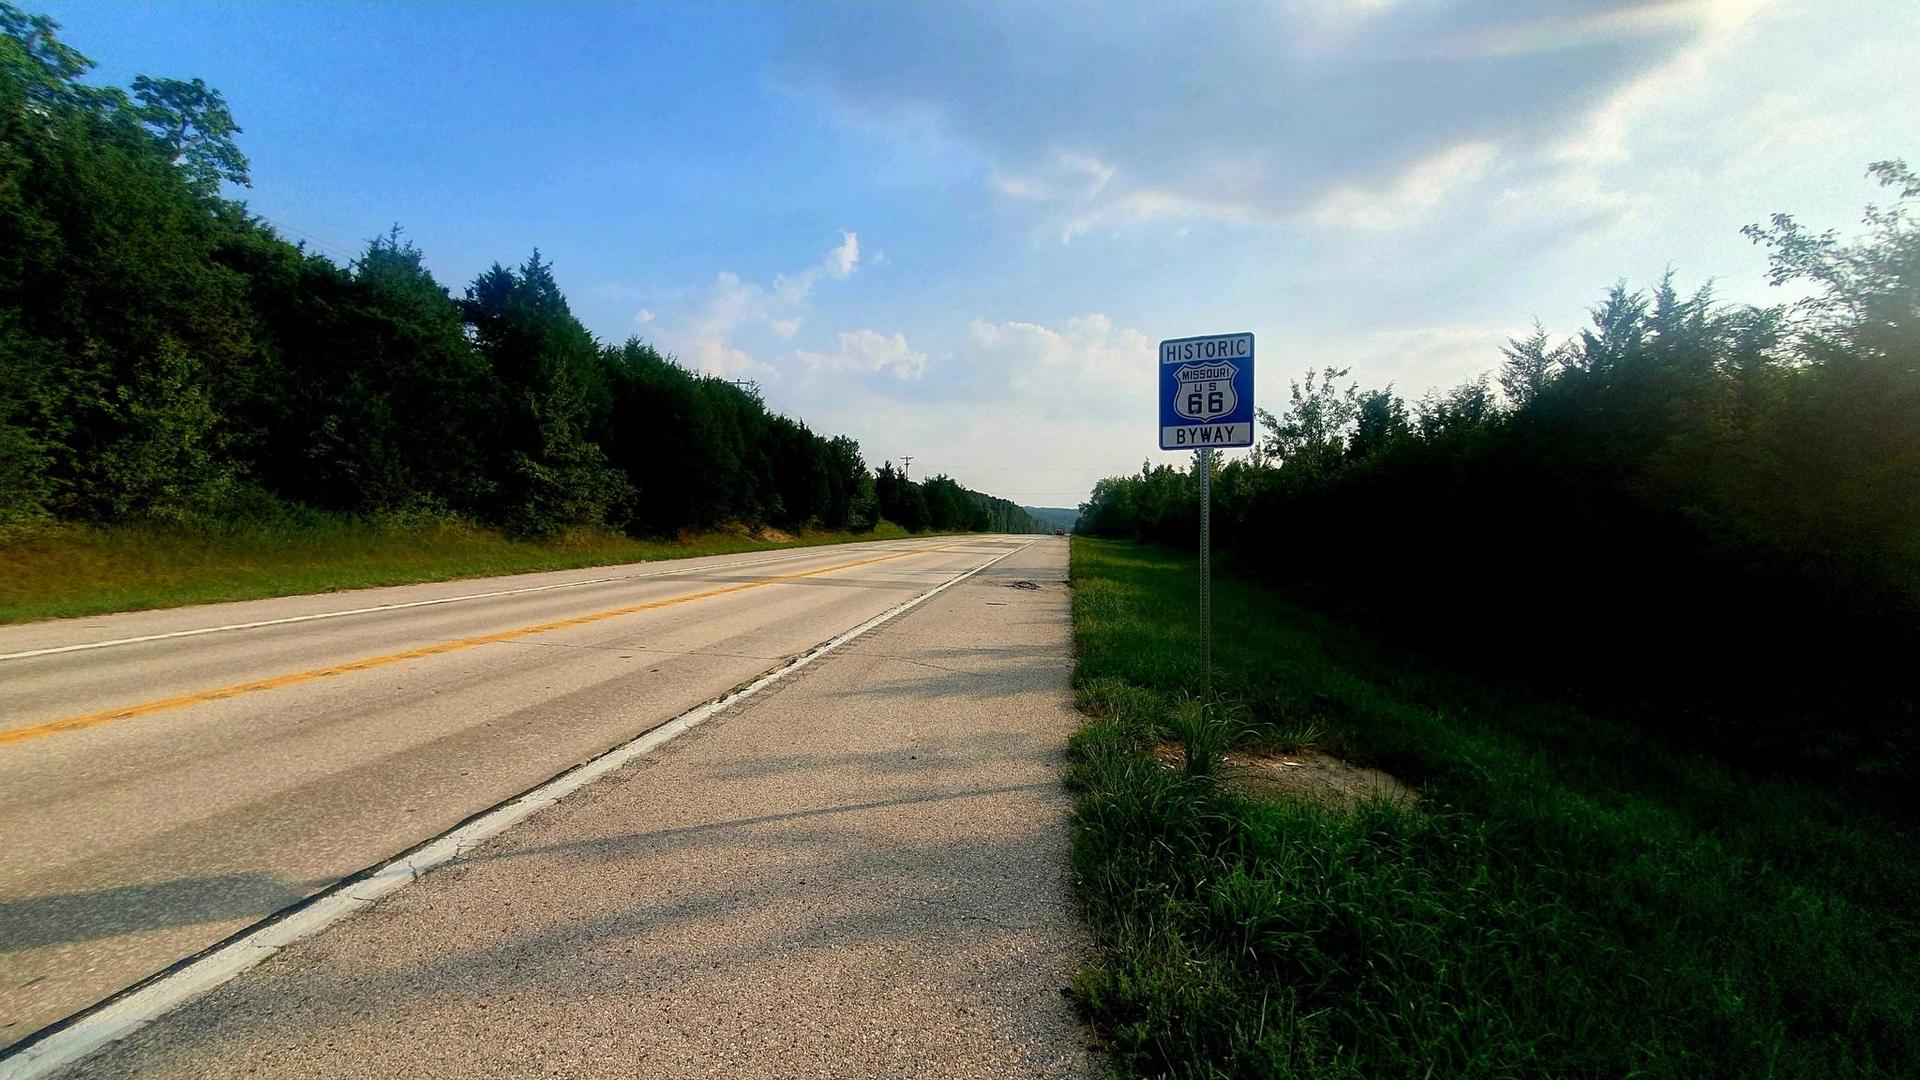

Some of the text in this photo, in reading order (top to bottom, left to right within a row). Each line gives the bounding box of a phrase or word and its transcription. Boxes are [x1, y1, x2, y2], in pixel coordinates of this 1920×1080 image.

[1166, 339, 1246, 361] HISTORIC
[1182, 368, 1230, 380] MISSOURI
[1187, 392, 1223, 414] 66
[1176, 425, 1235, 444] BYWAY
